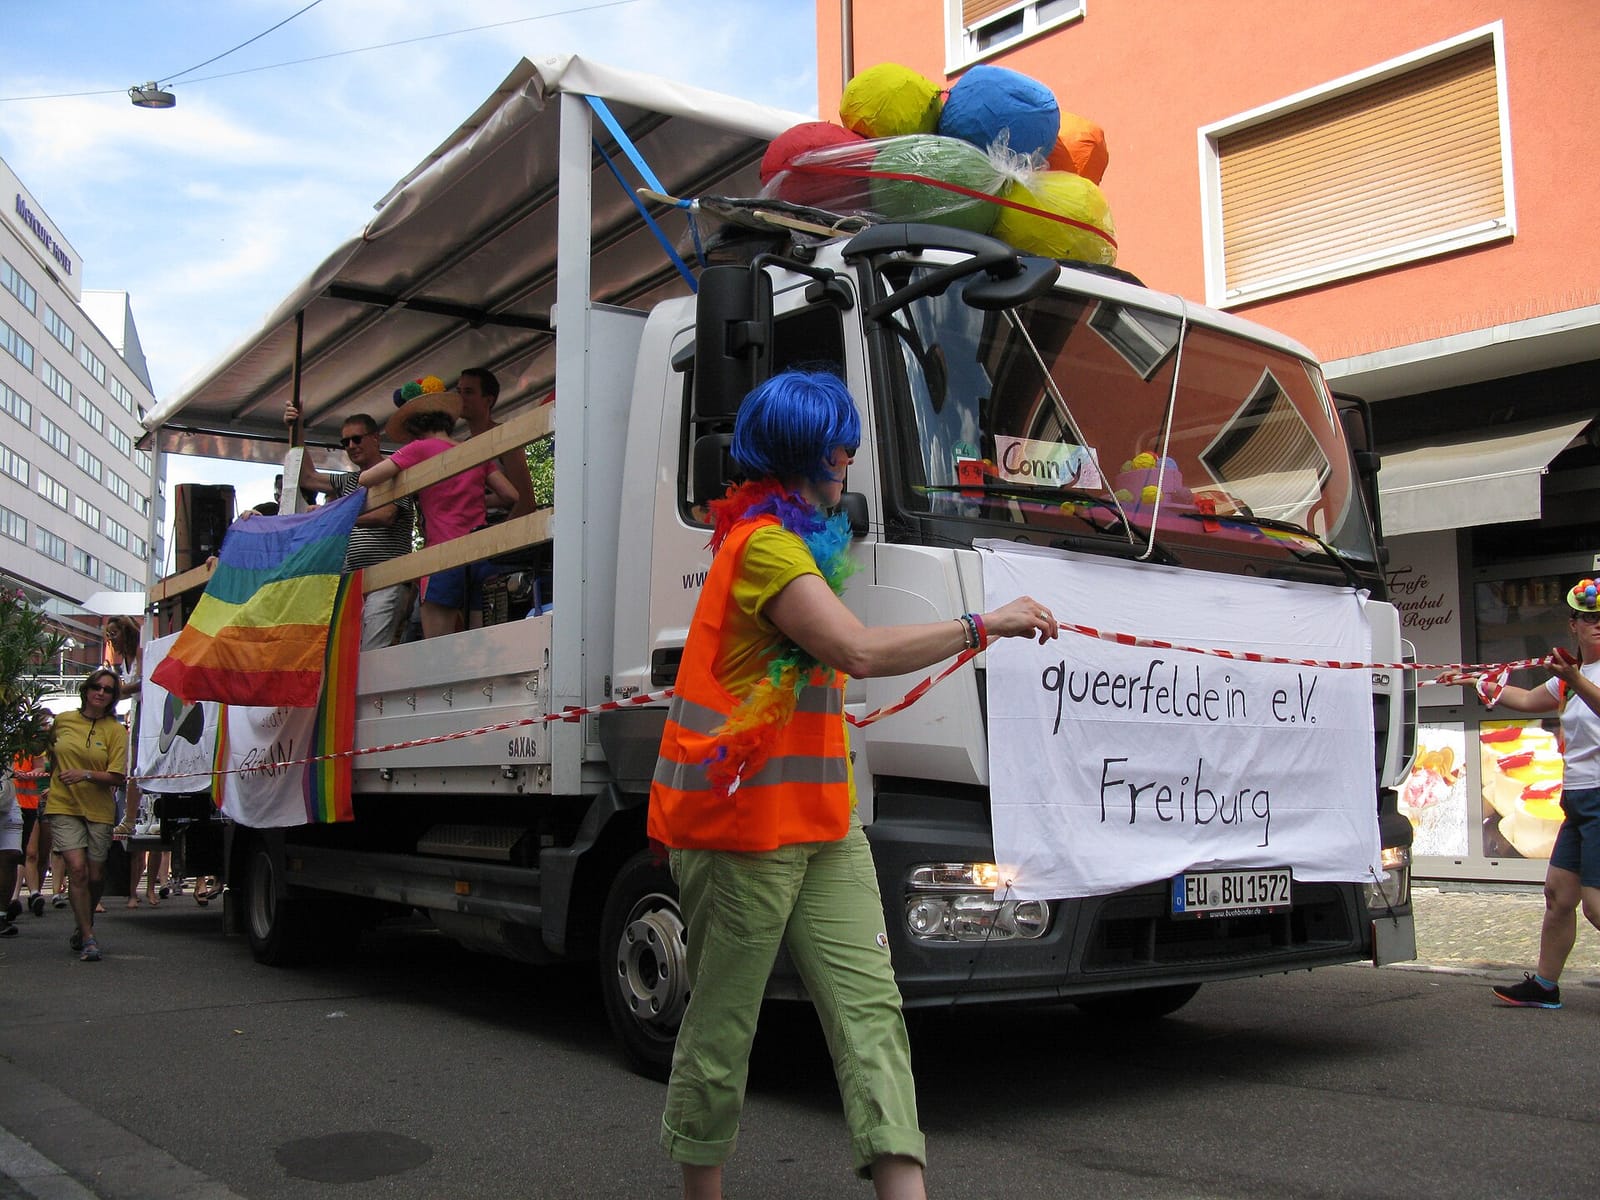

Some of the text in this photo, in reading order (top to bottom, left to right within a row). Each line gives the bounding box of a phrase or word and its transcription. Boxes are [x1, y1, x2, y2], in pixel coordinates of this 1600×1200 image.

[16, 193, 52, 251] Mercure
[1002, 441, 1082, 488] Conny
[1389, 593, 1444, 611] tanbul
[1402, 609, 1453, 631] Royal
[1041, 659, 1317, 735] queerfeldein e.V.
[508, 737, 537, 758] SAXAS
[1100, 757, 1270, 848] Freiburg
[1185, 877, 1208, 906] EU
[1222, 875, 1244, 904] BU
[1247, 874, 1288, 903] 1572
